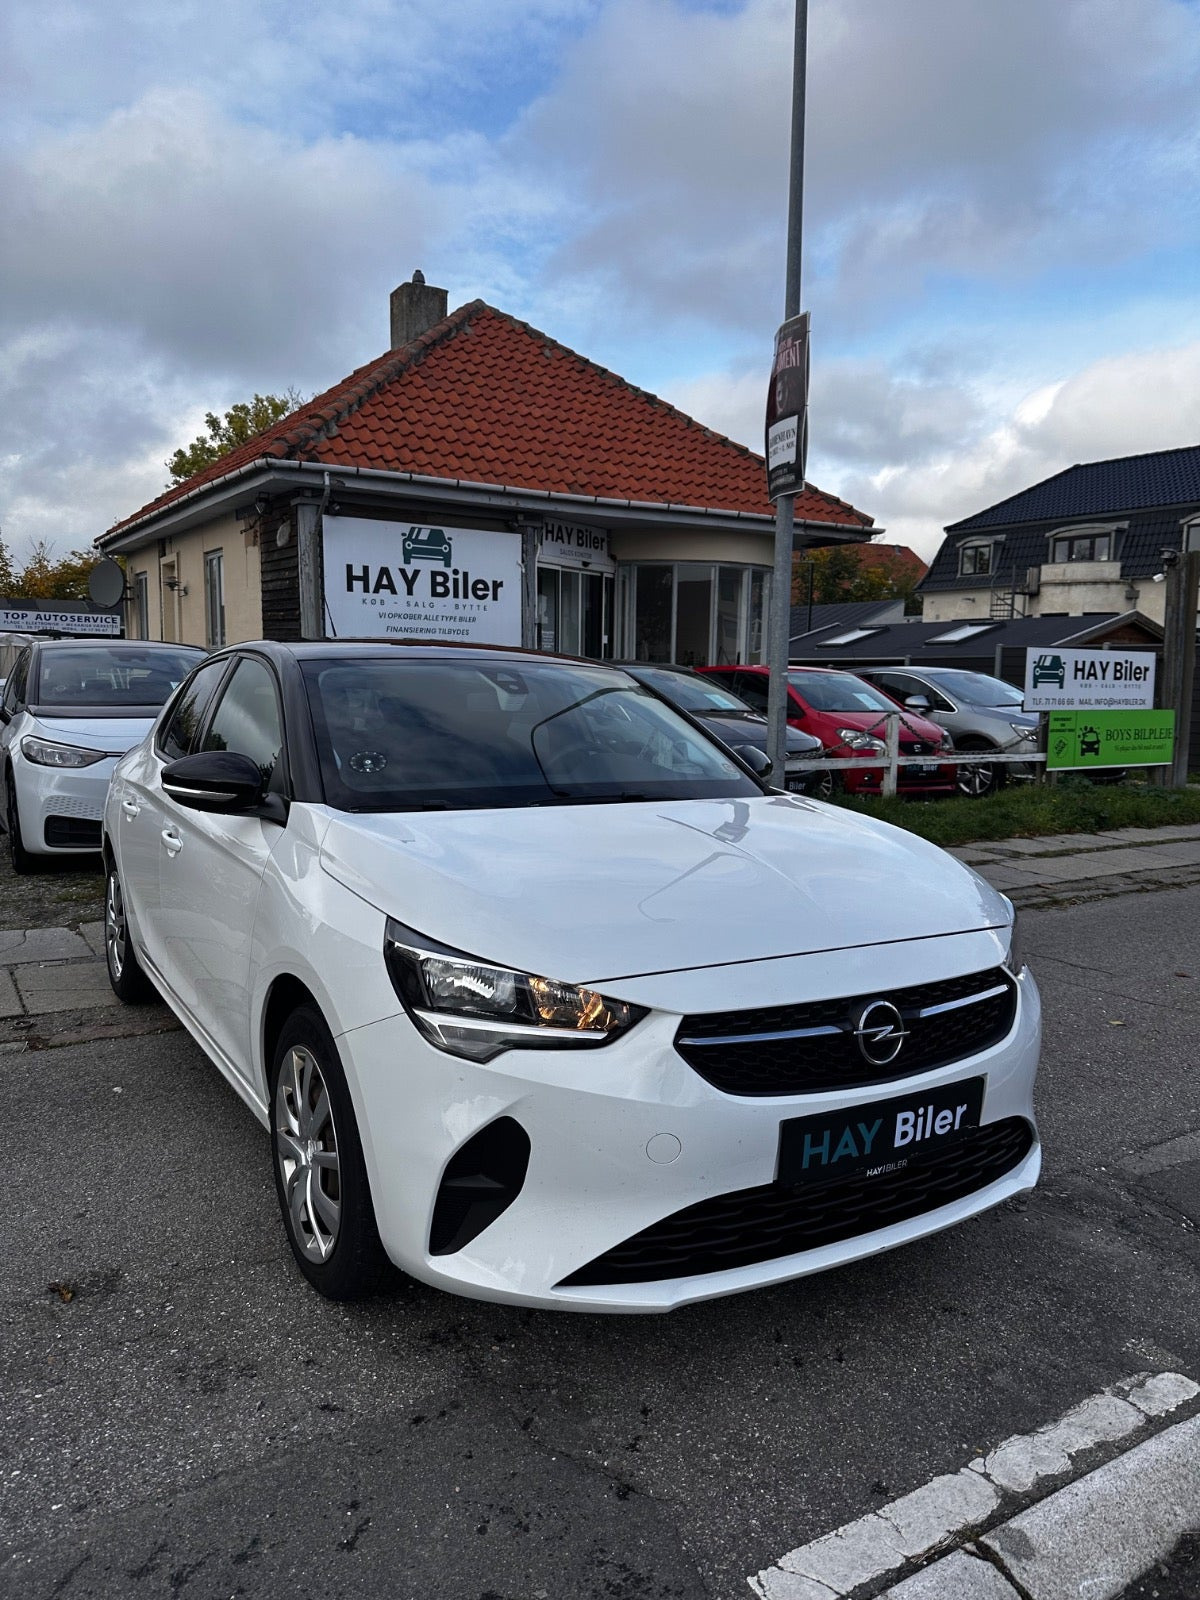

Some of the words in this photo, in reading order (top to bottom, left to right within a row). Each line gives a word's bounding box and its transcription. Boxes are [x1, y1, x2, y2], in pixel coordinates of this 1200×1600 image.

[544, 522, 574, 545] HAY
[576, 528, 606, 551] Biler
[346, 563, 421, 596] HAY
[430, 568, 504, 602] Biler
[362, 598, 385, 606] KØB
[406, 601, 435, 609] SALG
[455, 603, 488, 612] BYTTE
[3, 612, 28, 620] TOP
[35, 613, 118, 624] AUTOSERVICE
[423, 614, 440, 622] ALLE
[441, 615, 456, 623] TYPE
[386, 625, 437, 635] FINANSIERING
[438, 628, 470, 636] TILBYDES
[1073, 660, 1110, 681] HAY
[1113, 659, 1150, 682] Biler
[1105, 728, 1132, 742] BOYS
[788, 781, 806, 792] Biler
[801, 1117, 884, 1169] HAY
[893, 1103, 967, 1148] Biler
